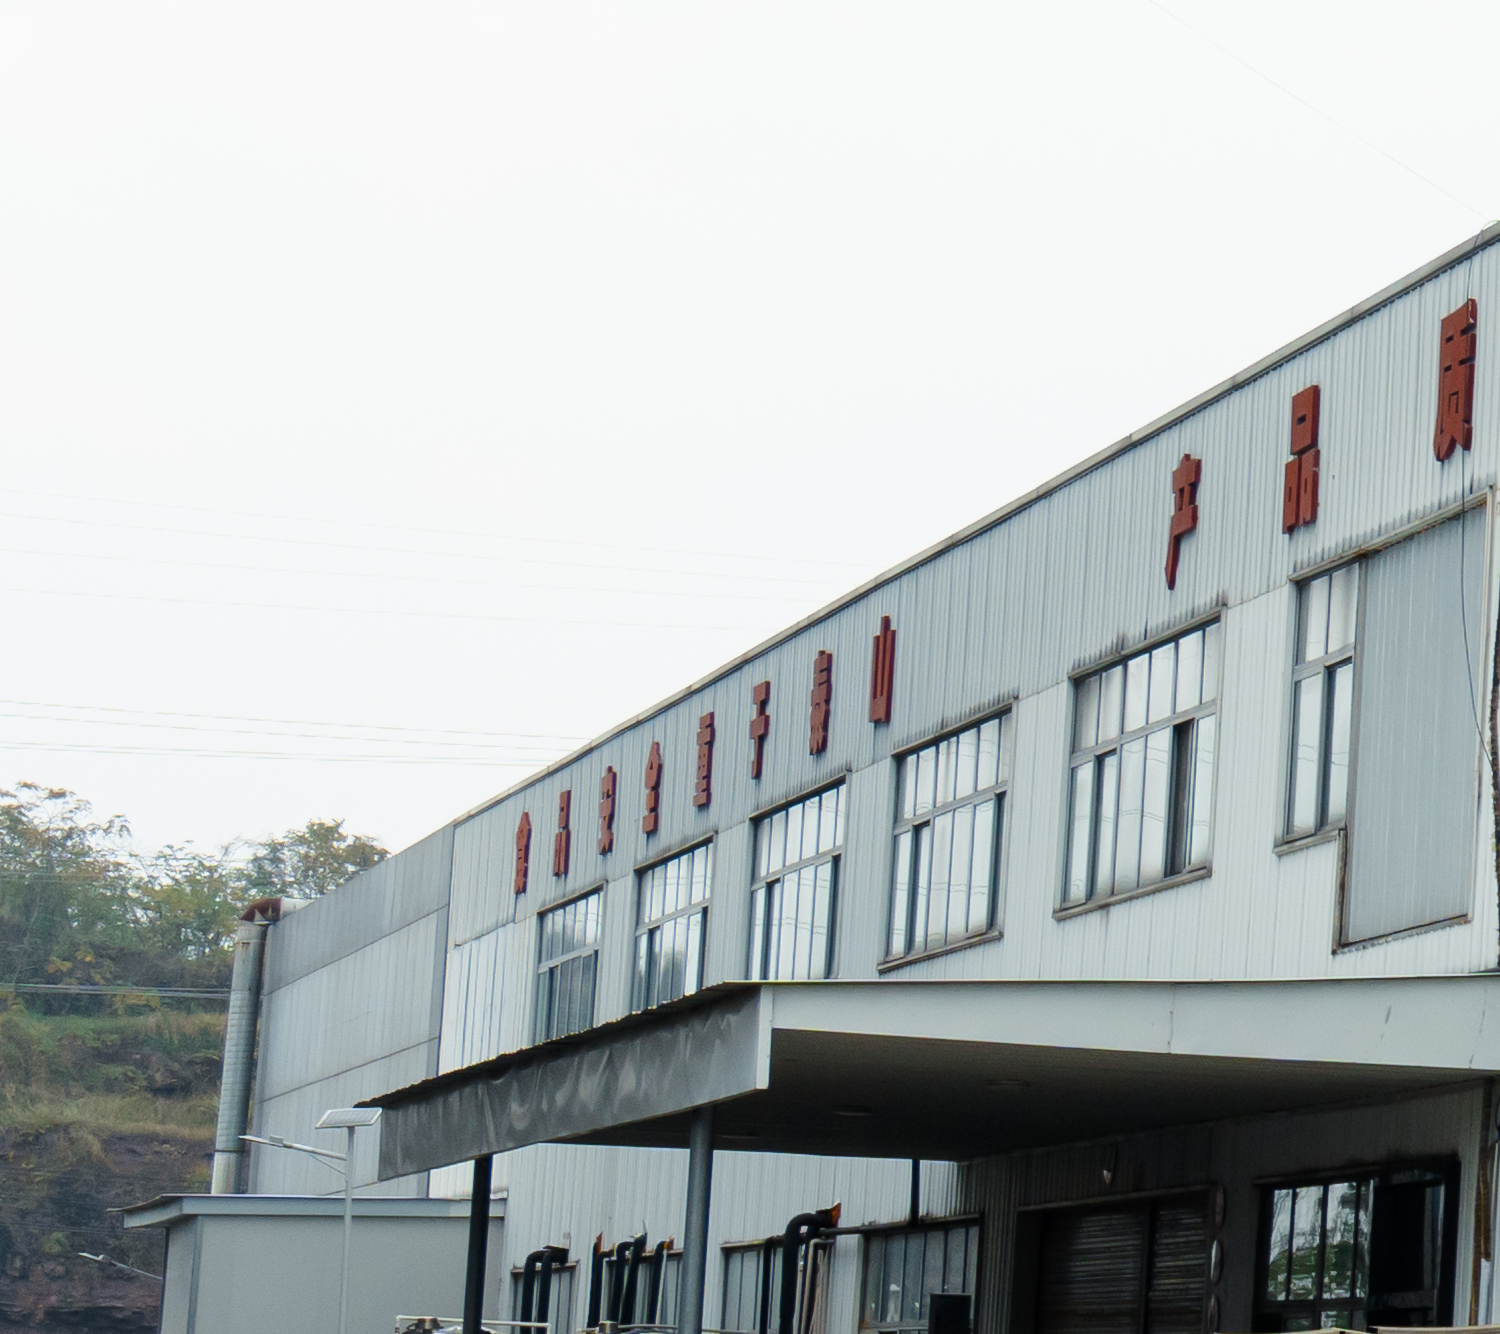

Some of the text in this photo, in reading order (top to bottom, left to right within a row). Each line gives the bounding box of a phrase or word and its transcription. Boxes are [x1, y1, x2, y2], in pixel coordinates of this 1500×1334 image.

[514, 615, 896, 895] 食品安全重于泰山
